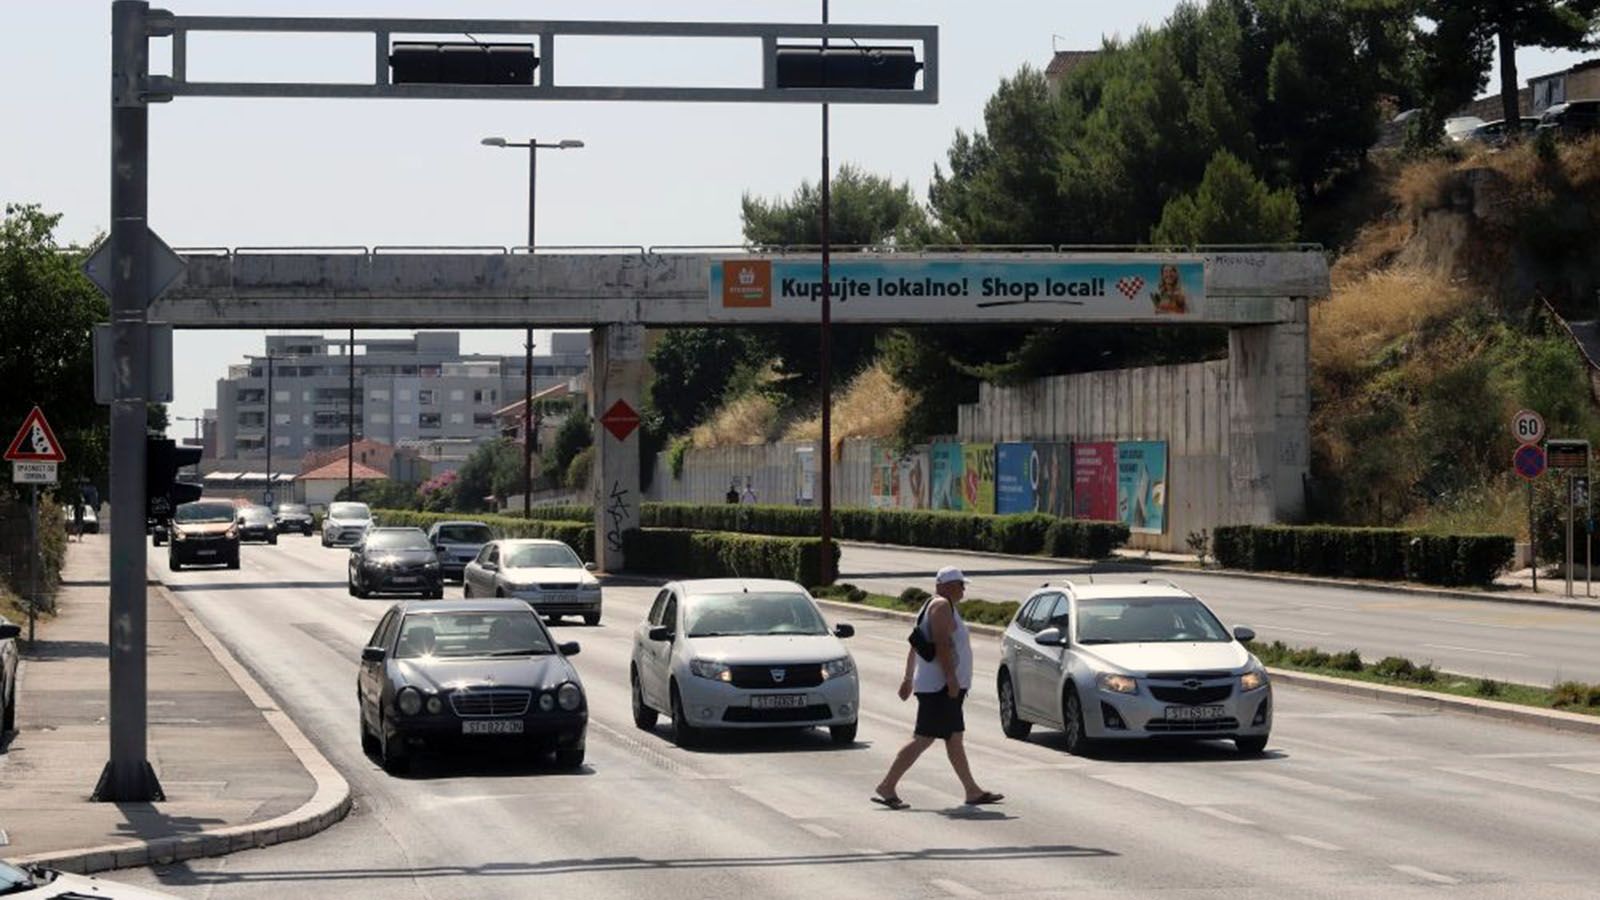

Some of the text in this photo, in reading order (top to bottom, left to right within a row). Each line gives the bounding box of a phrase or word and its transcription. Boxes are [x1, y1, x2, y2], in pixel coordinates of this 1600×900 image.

[782, 277, 871, 302] Kupujte
[877, 277, 969, 297] lokalno!
[981, 277, 1039, 302] Shop
[1045, 277, 1105, 297] local!
[1519, 418, 1538, 436] 60
